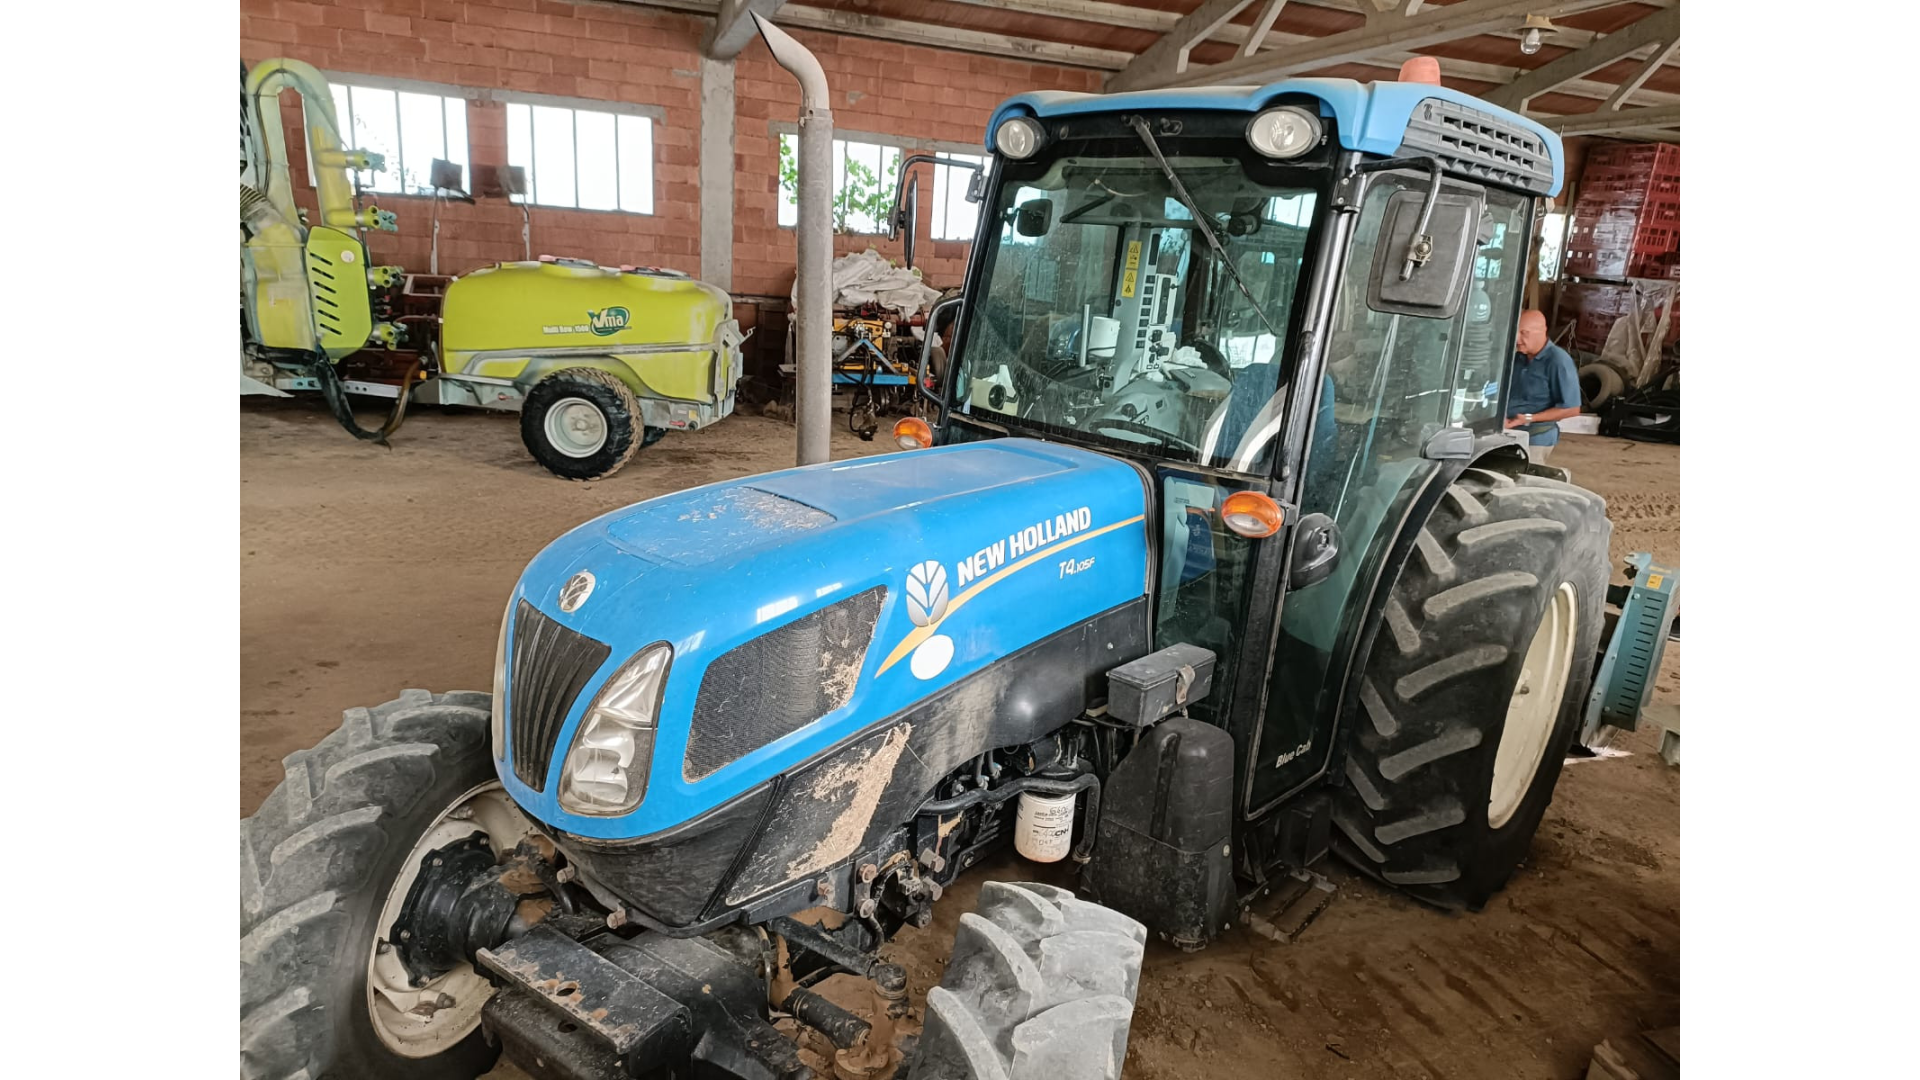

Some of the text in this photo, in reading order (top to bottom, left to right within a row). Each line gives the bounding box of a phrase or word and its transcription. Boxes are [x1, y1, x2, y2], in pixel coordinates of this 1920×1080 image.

[957, 506, 1092, 588] NEW HOLLAND
[1059, 556, 1096, 580] T4.105F
[1275, 739, 1312, 769] Blue Cab
